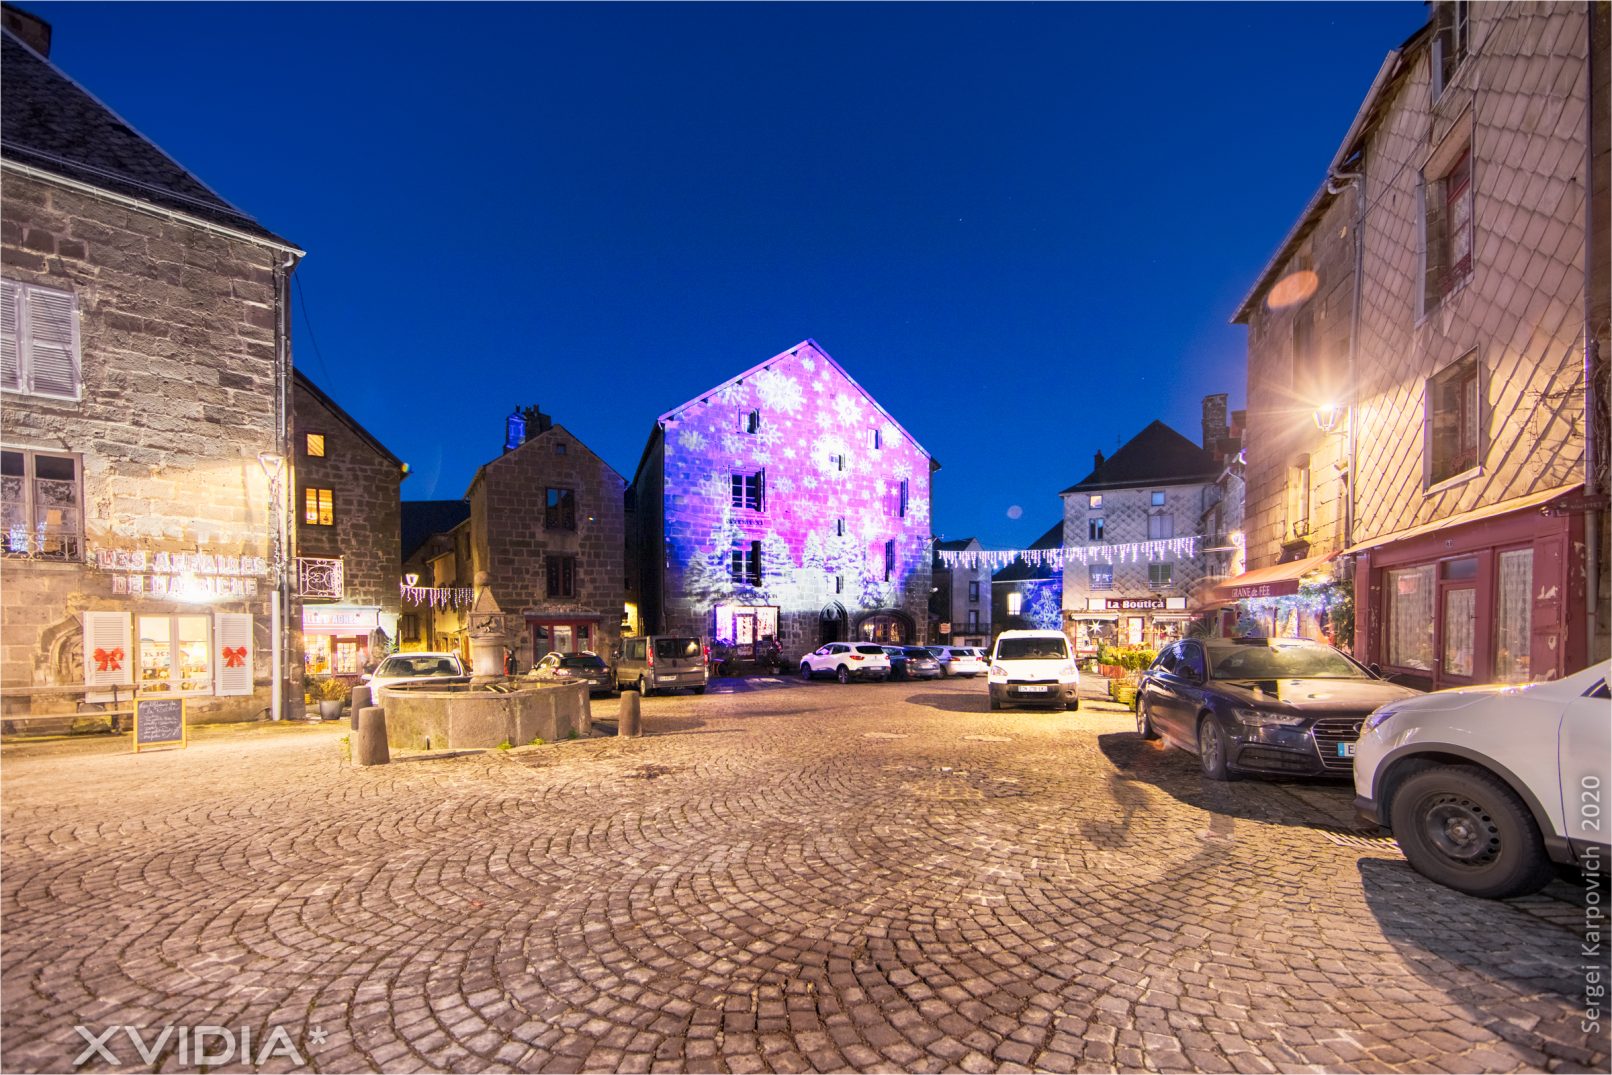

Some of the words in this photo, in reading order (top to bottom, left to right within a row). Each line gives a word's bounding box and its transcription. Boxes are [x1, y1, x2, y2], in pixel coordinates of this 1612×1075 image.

[97, 550, 145, 570] LES
[154, 552, 267, 574] AFFAIRES
[1107, 600, 1120, 609] La
